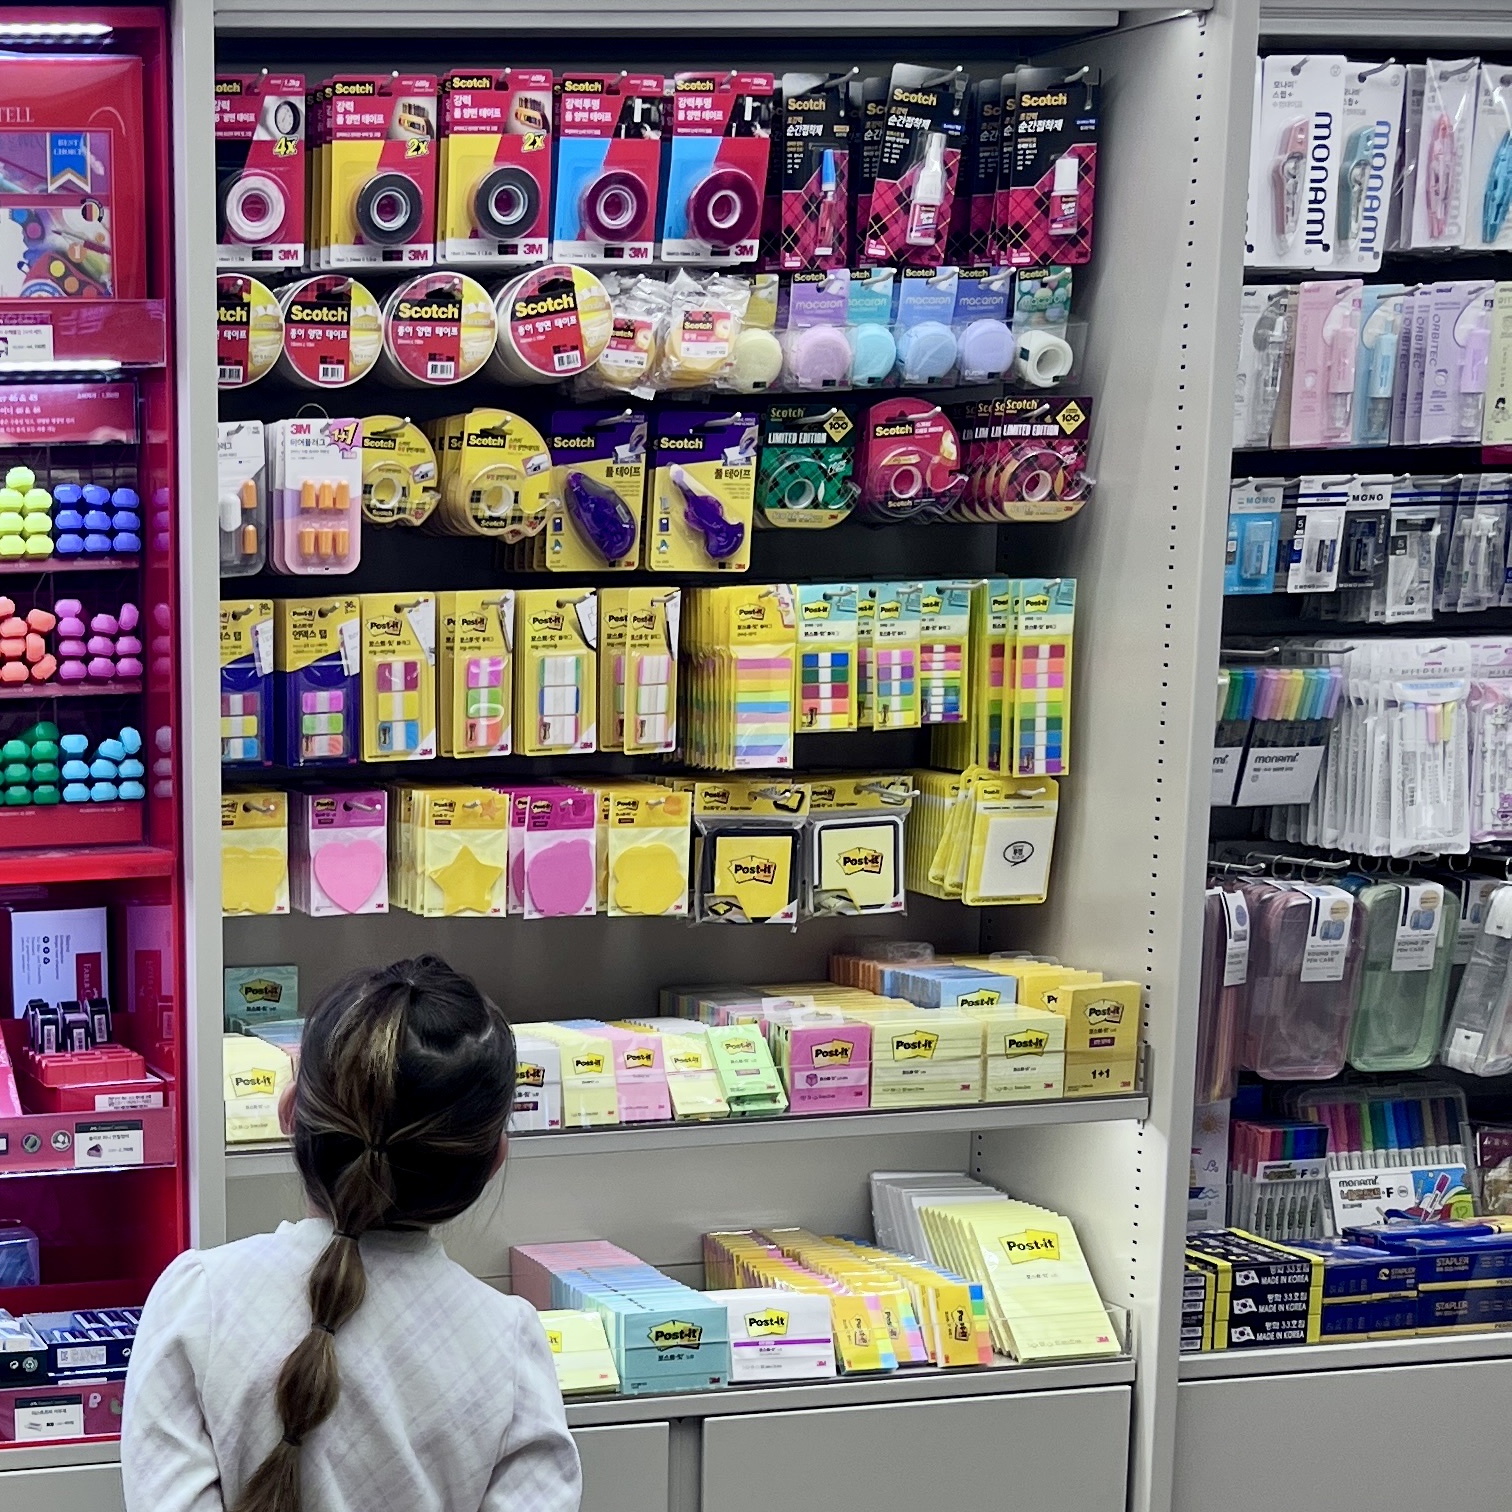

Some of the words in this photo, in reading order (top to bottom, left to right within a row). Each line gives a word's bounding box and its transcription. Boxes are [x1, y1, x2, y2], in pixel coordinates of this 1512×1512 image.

[452, 77, 490, 88] Scotch
[565, 81, 602, 92] Scotch
[677, 80, 714, 91] Scotch
[335, 83, 375, 95] Scotch
[893, 89, 937, 106] Scotch
[1021, 94, 1067, 107] Scotch
[788, 99, 826, 111] Scotch
[1305, 111, 1331, 251] monami
[1359, 121, 1391, 260] monami
[278, 249, 299, 261] 3M
[408, 249, 428, 261] 3M
[523, 244, 543, 255] 3M
[629, 248, 648, 258] 3M
[735, 245, 754, 256] 3M
[794, 272, 825, 282] Scotch
[905, 268, 935, 278] Scotch
[959, 268, 988, 278] Scotch
[1020, 270, 1049, 280] Scotch
[515, 294, 575, 318] Scotch
[796, 298, 844, 311] macaron
[906, 296, 951, 306] macaron
[959, 296, 1004, 308] macaron
[291, 306, 349, 321] Scotch
[398, 303, 459, 319] Scotch
[554, 317, 577, 330] 테이프
[684, 320, 713, 330] Scotch
[326, 328, 348, 339] 테이프
[435, 326, 458, 337] 테이프
[1006, 399, 1038, 413] Scotch
[770, 407, 805, 418] Scotch
[291, 424, 311, 434] 3M
[875, 425, 913, 437] Scotch
[1003, 425, 1031, 436] LIMITED
[1032, 425, 1060, 436] EDITION
[363, 438, 394, 448] Scotch
[467, 435, 505, 447] Scotch
[554, 437, 595, 448] Scotch
[660, 437, 703, 449] Scotch
[768, 432, 797, 444] LIMITED
[799, 432, 827, 444] EDITION
[615, 466, 641, 477] 테이프
[724, 469, 751, 479] 테이프
[1352, 493, 1384, 502] MONO
[1025, 600, 1049, 610] Post-it
[739, 608, 765, 618] Post-it
[804, 606, 829, 616] Post-it
[461, 617, 485, 626] Post-it
[532, 616, 562, 625] Post-it
[633, 615, 654, 624] Post-it
[370, 621, 399, 631] Post-it
[1254, 752, 1299, 764] monami
[843, 854, 881, 867] Post-it
[736, 863, 774, 876] Post-it
[245, 986, 281, 997] Post-it
[961, 997, 996, 1008] Post-it
[1088, 1008, 1120, 1018] Post-it
[725, 1041, 753, 1051] Post-it
[895, 1039, 934, 1052] Post-it
[1008, 1038, 1045, 1050] Post-it
[626, 1052, 652, 1061] Post-it
[815, 1046, 850, 1060] Post-it
[575, 1058, 602, 1068] Post-it
[1090, 1069, 1111, 1079] 1+1
[235, 1076, 272, 1088] Post-it
[1339, 1176, 1380, 1187] monami
[1007, 1238, 1054, 1252] Post-it
[1261, 1275, 1276, 1284] MADE
[1278, 1275, 1286, 1284] IN
[1288, 1274, 1309, 1284] KOREA
[1259, 1304, 1274, 1313] MADE
[1276, 1303, 1284, 1312] IN
[1286, 1302, 1307, 1312] KOREA
[748, 1316, 785, 1328] Post-it
[655, 1328, 698, 1342] Post-it
[1257, 1331, 1272, 1341] MADE
[1274, 1331, 1282, 1340] IN
[1284, 1330, 1304, 1340] KOREA
